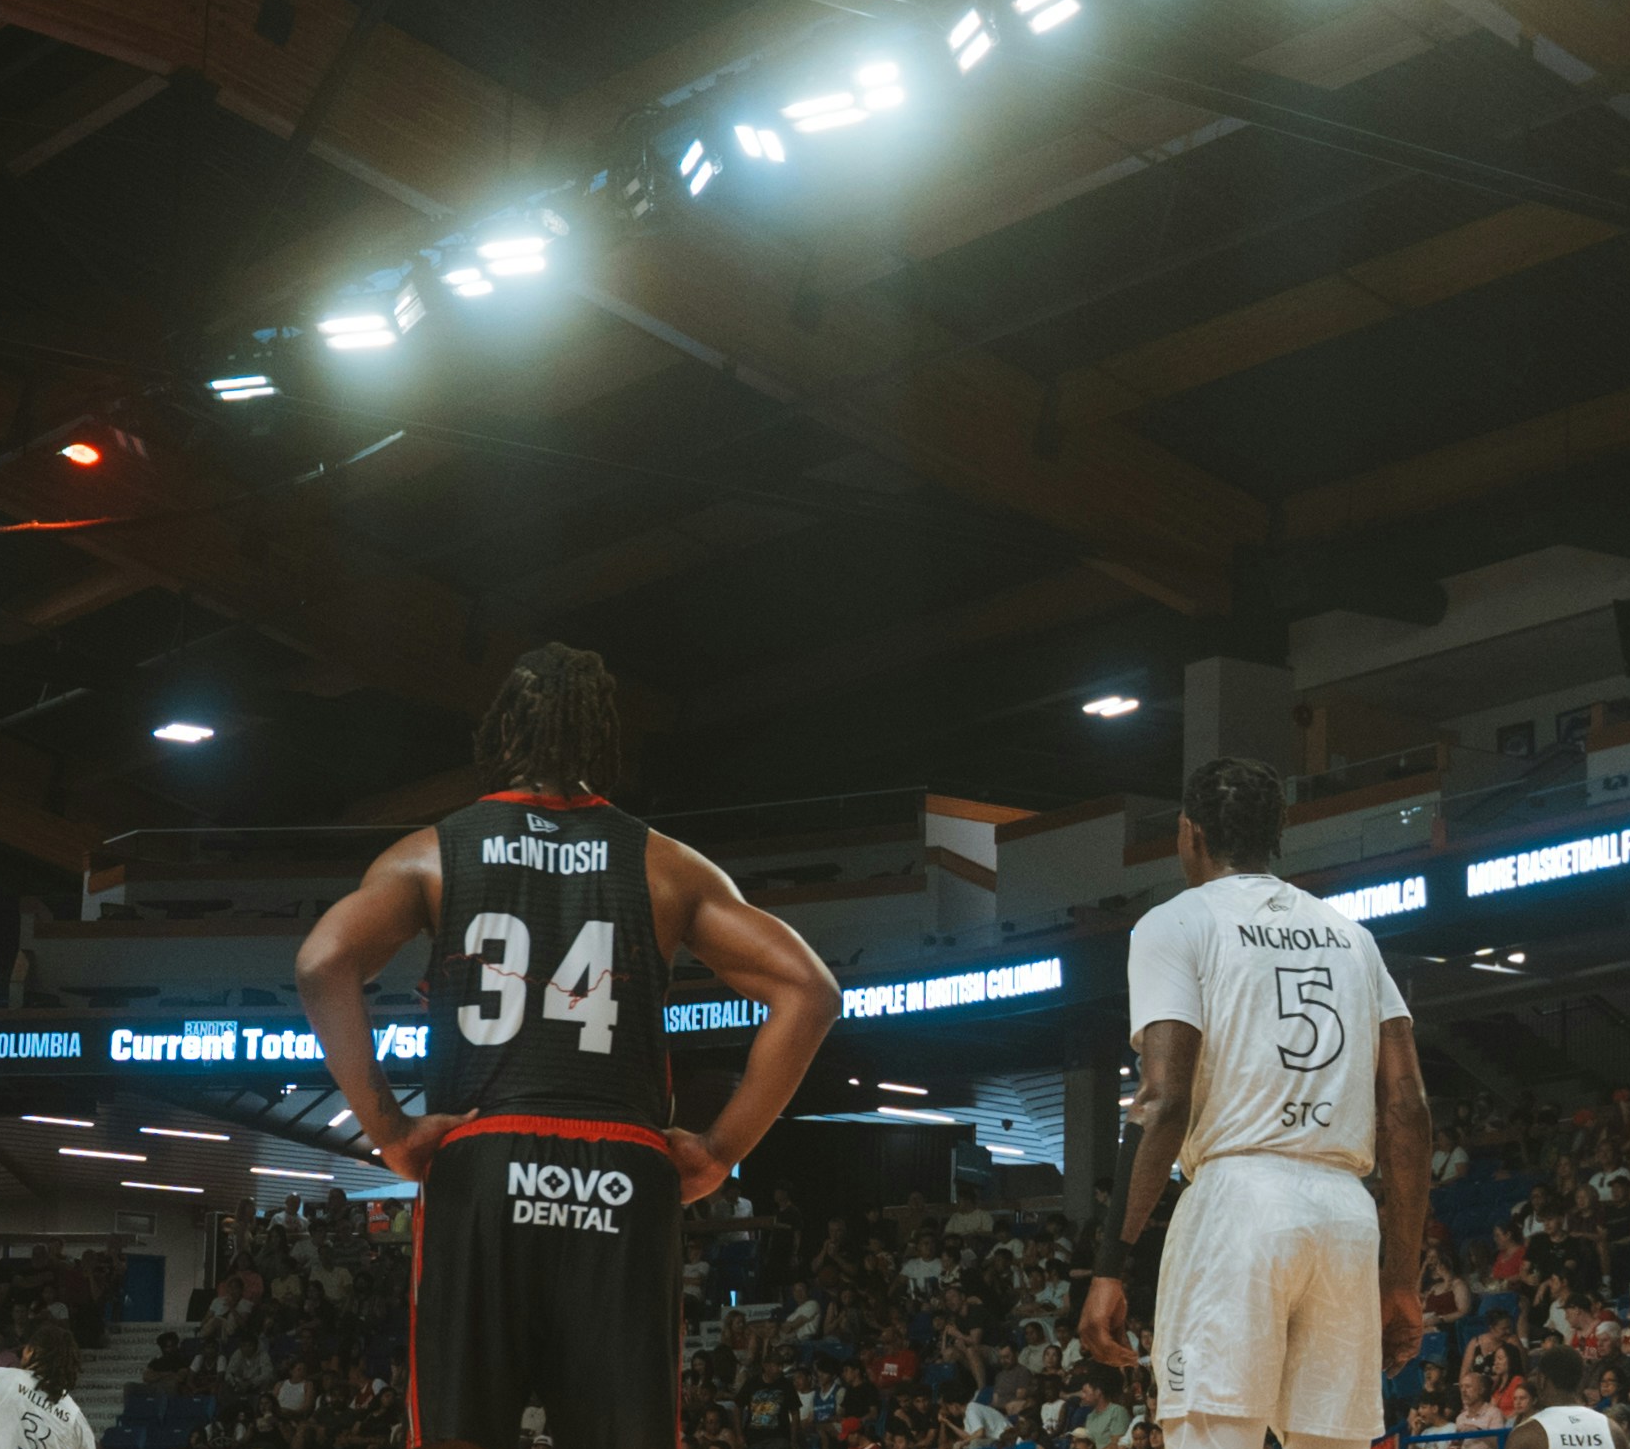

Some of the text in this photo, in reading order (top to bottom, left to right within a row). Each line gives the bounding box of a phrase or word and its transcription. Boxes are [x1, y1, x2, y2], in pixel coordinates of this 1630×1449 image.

[483, 836, 608, 874] McINTOSH
[1467, 855, 1517, 897] MORE
[1517, 832, 1621, 887] BASKETBALL
[1237, 924, 1351, 950] NICHOLAS
[457, 912, 619, 1054] 34
[843, 957, 1061, 1018] PEOPLE IN BRITISH COLUMBIA
[1275, 967, 1345, 1072] 5
[111, 1029, 236, 1062] Current
[1281, 1102, 1332, 1128] STC
[508, 1162, 633, 1205] NOVO
[513, 1199, 619, 1234] DENTAL
[18, 1384, 70, 1423] WILLIAMS
[1560, 1434, 1602, 1447] ELVIS
